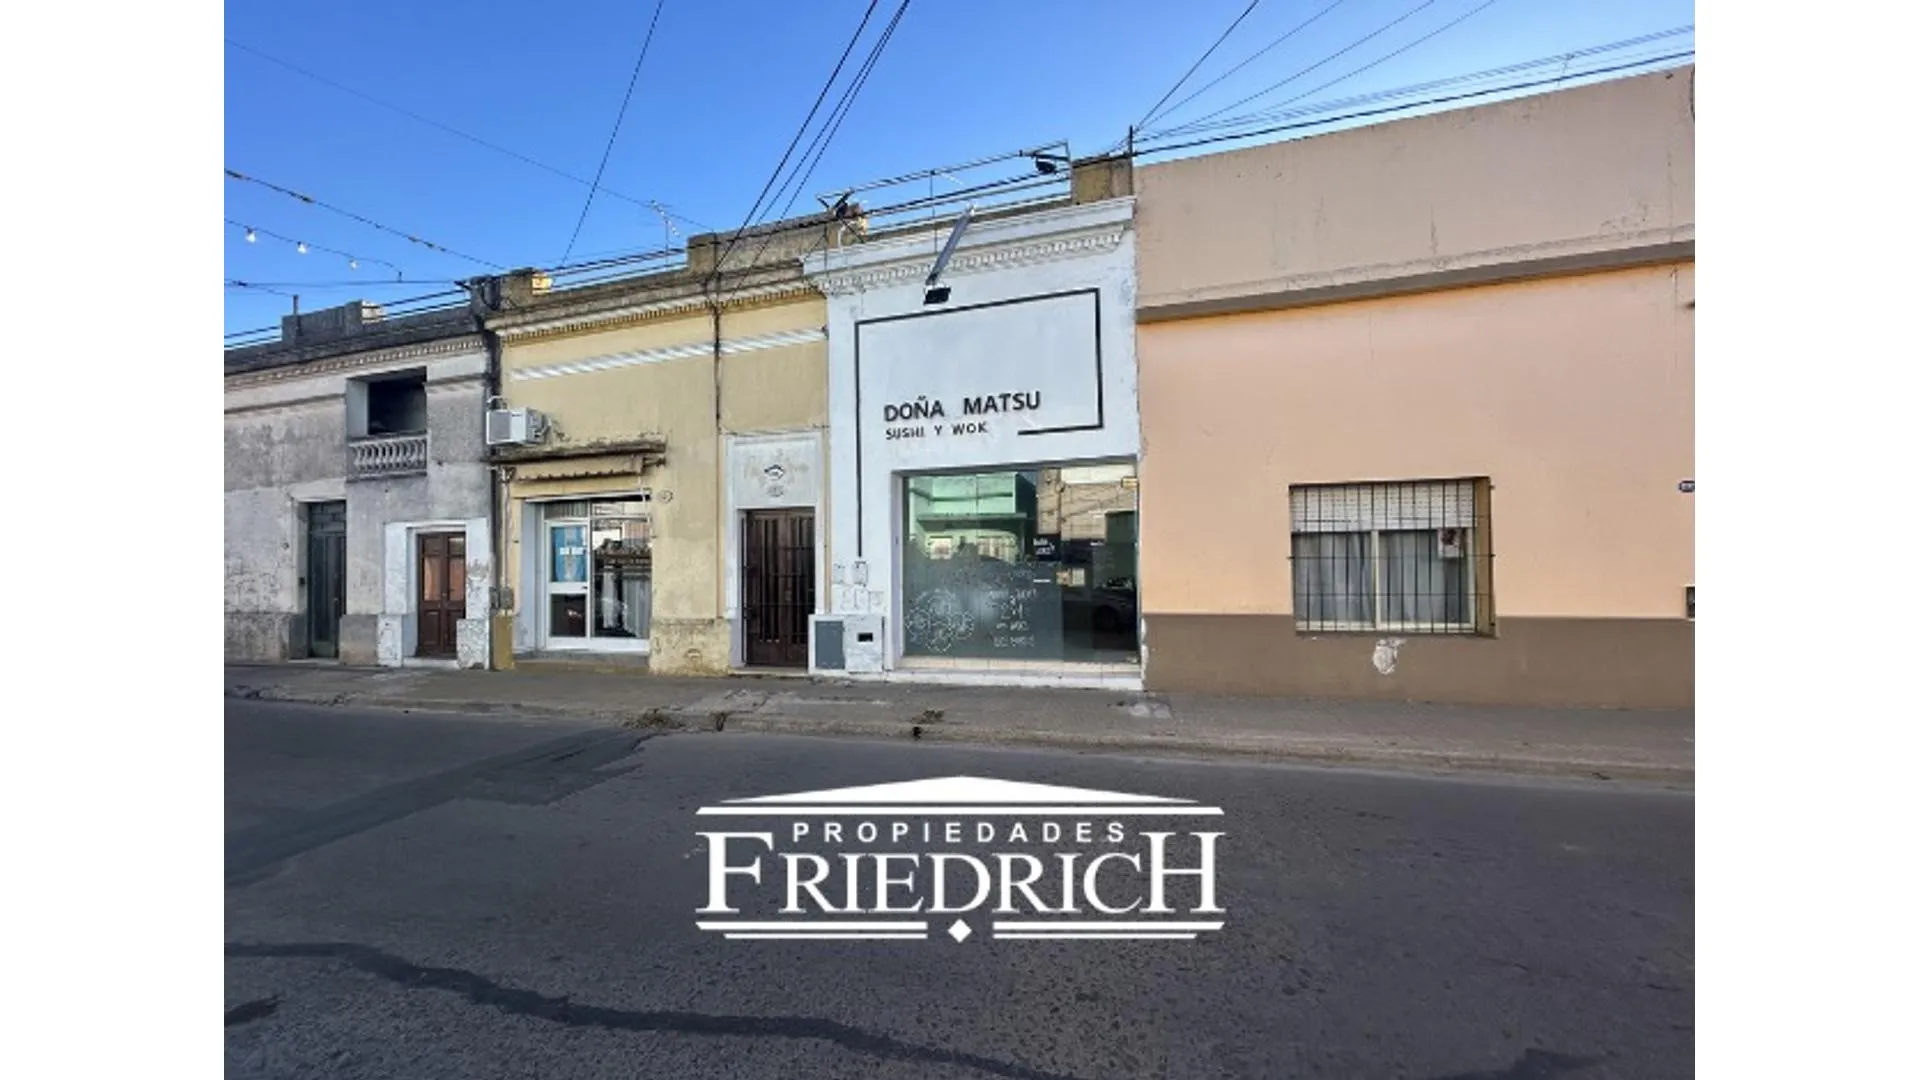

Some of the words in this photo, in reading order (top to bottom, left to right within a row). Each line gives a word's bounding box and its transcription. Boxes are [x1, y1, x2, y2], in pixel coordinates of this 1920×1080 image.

[884, 395, 945, 422] DOÑA
[963, 391, 1040, 415] MATSU
[886, 426, 925, 440] SUSHI
[934, 425, 943, 436] Y
[952, 422, 989, 436] WOK
